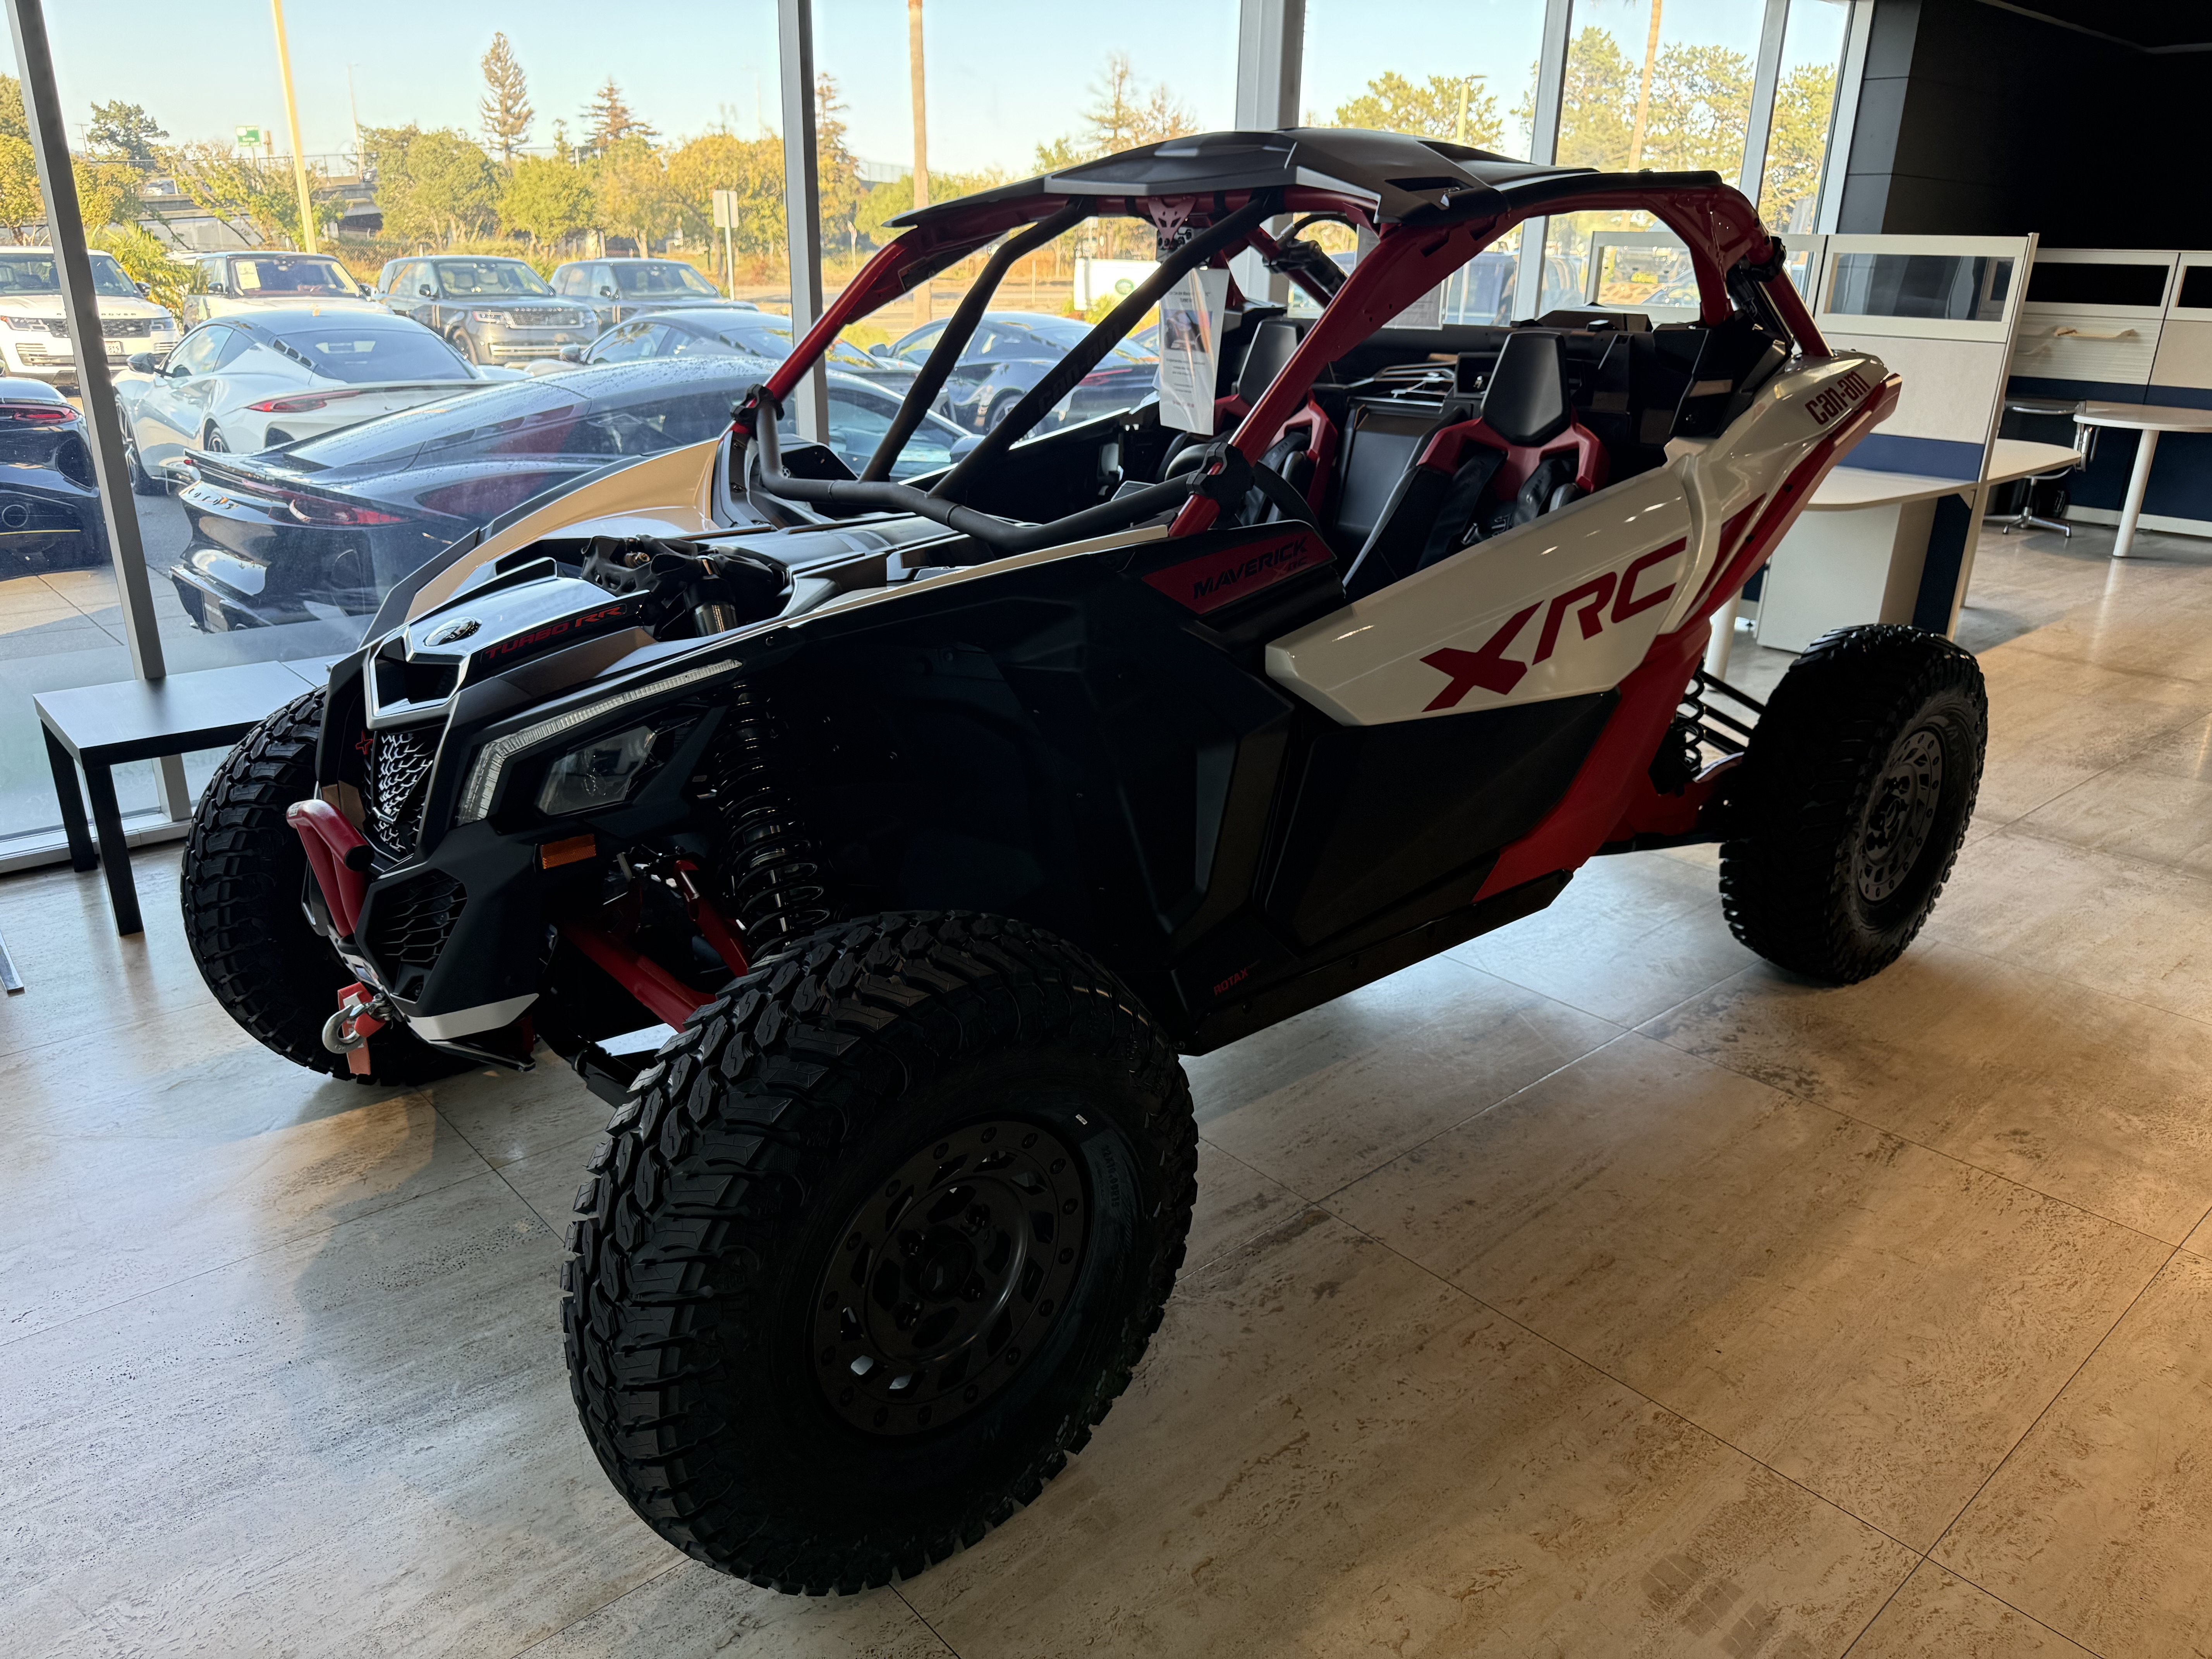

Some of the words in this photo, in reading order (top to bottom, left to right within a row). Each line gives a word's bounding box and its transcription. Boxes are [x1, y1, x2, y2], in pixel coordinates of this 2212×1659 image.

[1805, 371, 1871, 425] can-am
[1193, 536, 1308, 600] MAVERICK
[485, 622, 570, 659] TURBO
[575, 607, 620, 628] RR
[1420, 536, 1687, 712] XRC
[1213, 966, 1252, 997] ROTAX
